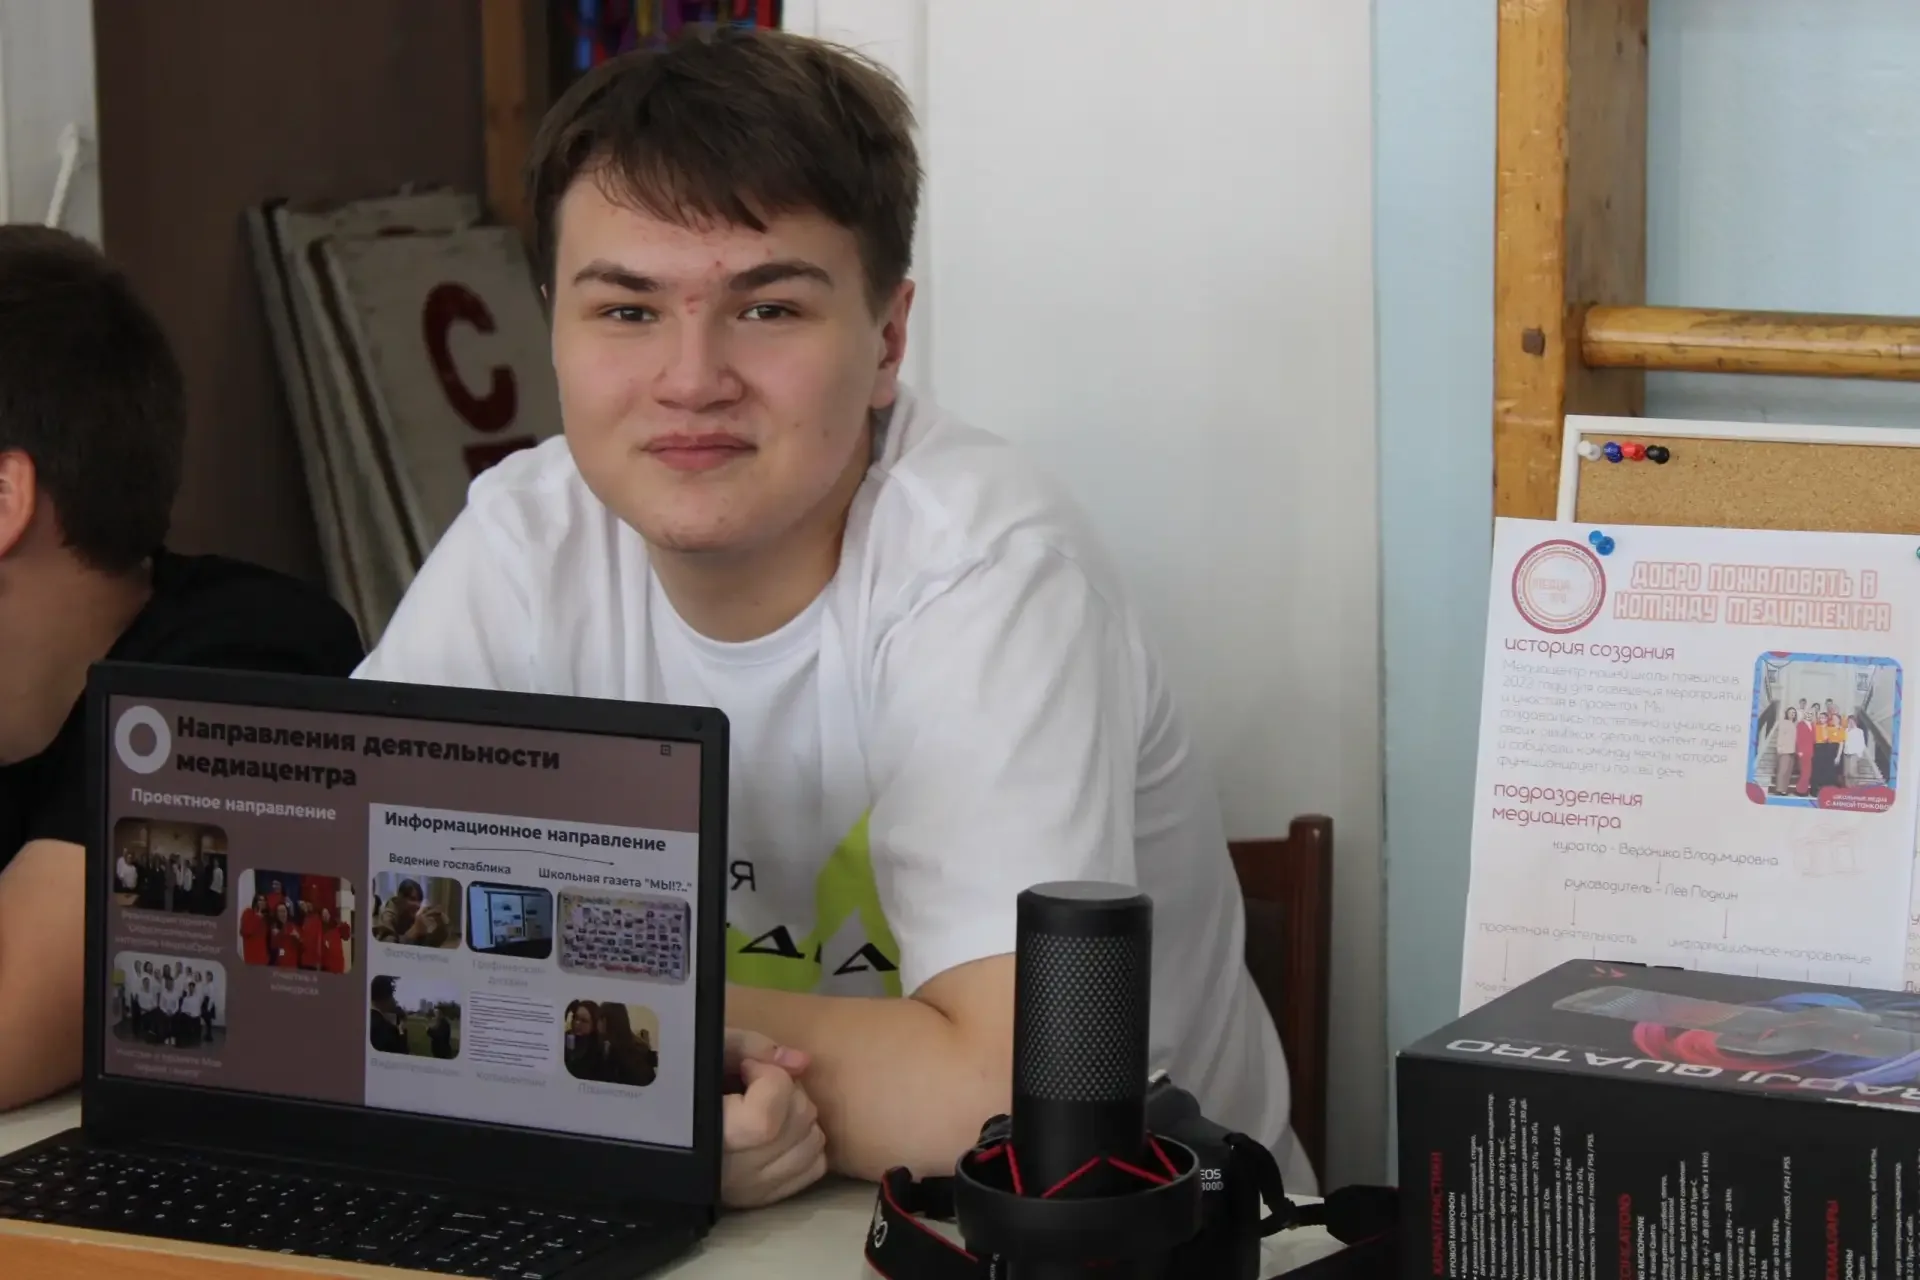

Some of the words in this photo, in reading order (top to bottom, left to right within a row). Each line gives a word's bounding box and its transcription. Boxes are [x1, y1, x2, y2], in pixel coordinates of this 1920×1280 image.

[1631, 561, 1701, 591] ДОБРО
[1709, 564, 1854, 599] ПОЖАЛОВАТЬ
[1861, 569, 1877, 599] В
[1613, 591, 1719, 623] КОМАНДУ
[1725, 596, 1892, 632] МЕДИАЦЕНТРА
[1504, 637, 1585, 659] история
[1590, 643, 1675, 663] создания
[177, 715, 356, 753] Направления
[363, 735, 560, 770] деятельности
[176, 754, 357, 789] медиацентра
[131, 788, 221, 810] Проектное
[225, 797, 337, 820] направление
[1493, 784, 1643, 807] подразделения
[384, 810, 542, 841] Информационное
[547, 828, 667, 852] направление
[1491, 807, 1622, 834] медиацентра
[1552, 839, 1607, 856] куратор
[1618, 842, 1681, 860] Вероника
[388, 852, 440, 869] Ведение
[443, 858, 512, 875] госпаблика
[538, 867, 600, 884] Школьная
[603, 874, 642, 889] газета
[1564, 878, 1652, 895] руководитель
[1445, 1038, 1725, 1080] QUATRO
[1576, 1181, 1584, 1194] 192
[1783, 1176, 1791, 1189] PS4
[1448, 1192, 1456, 1239] МИКРОФОН
[1690, 1204, 1698, 1216] 2.0
[1725, 1202, 1733, 1212] 20
[1783, 1195, 1791, 1220] macOS
[1690, 1217, 1698, 1232] USB
[1725, 1229, 1733, 1239] 20
[1637, 1215, 1645, 1269] MICROPHONE
[1773, 1248, 1780, 1256] to
[1783, 1226, 1791, 1258] Windows
[1448, 1240, 1456, 1277] ИГРОВОЙ
[1774, 1256, 1781, 1266] up
